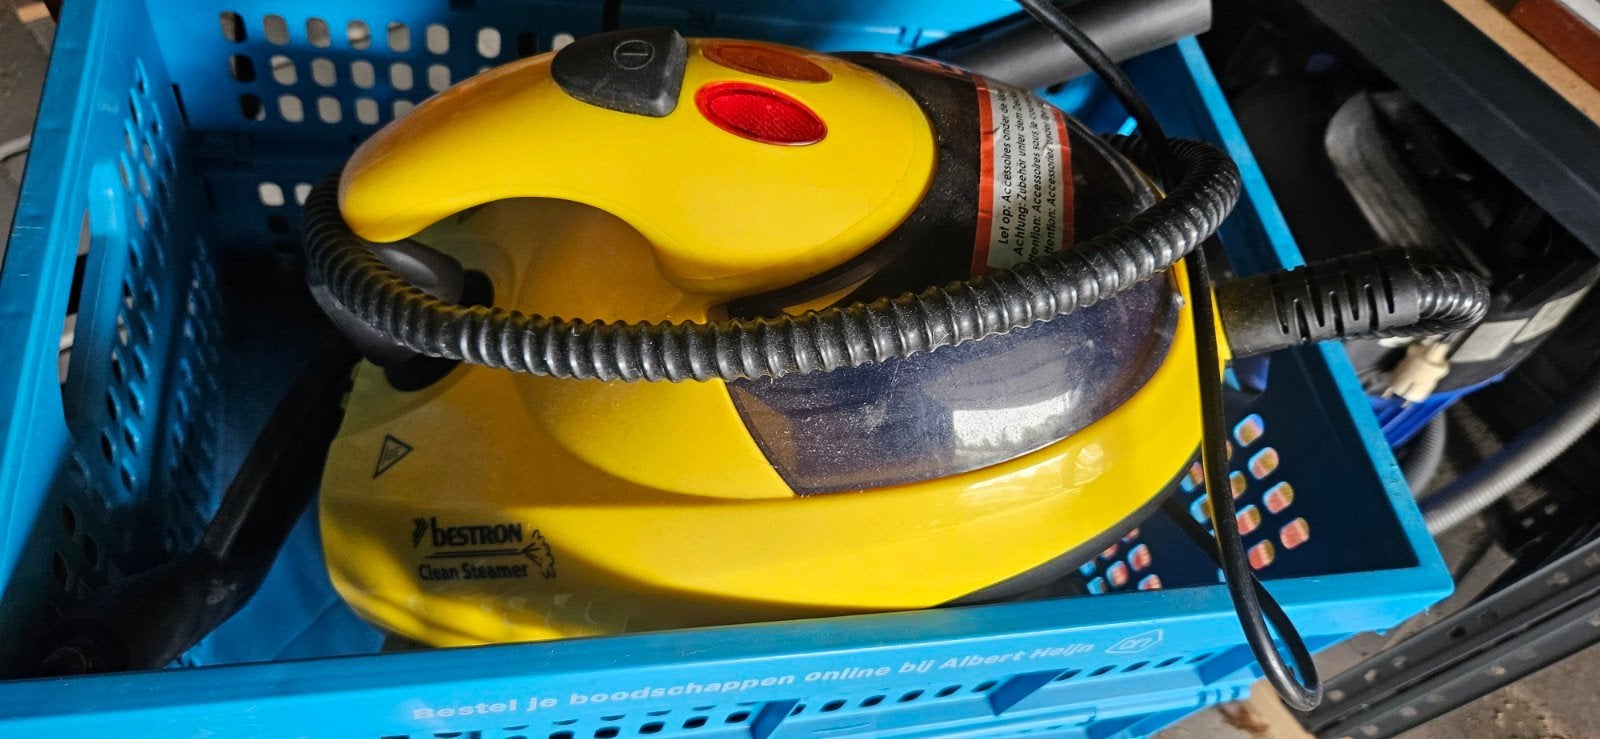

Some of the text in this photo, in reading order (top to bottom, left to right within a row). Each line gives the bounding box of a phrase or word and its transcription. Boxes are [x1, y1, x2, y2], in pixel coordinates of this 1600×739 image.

[999, 103, 1008, 113] de
[1015, 112, 1025, 132] dem
[1000, 114, 1010, 141] onder
[1015, 133, 1026, 157] unter
[1031, 131, 1040, 151] sous
[1001, 143, 1012, 203] Accessoires
[1016, 158, 1027, 201] Zubehör
[1031, 152, 1042, 214] Accessoires
[1045, 147, 1056, 207] Accessories
[1003, 205, 1013, 224] op:
[1013, 203, 1028, 257] Achtung:
[1044, 208, 1056, 255] ttention:
[998, 226, 1009, 245] Let
[1027, 215, 1042, 261] ttention:
[418, 562, 528, 581] Clean Steamer
[412, 643, 1096, 720] Bestel je boodschappen online bij Albert Heijn
